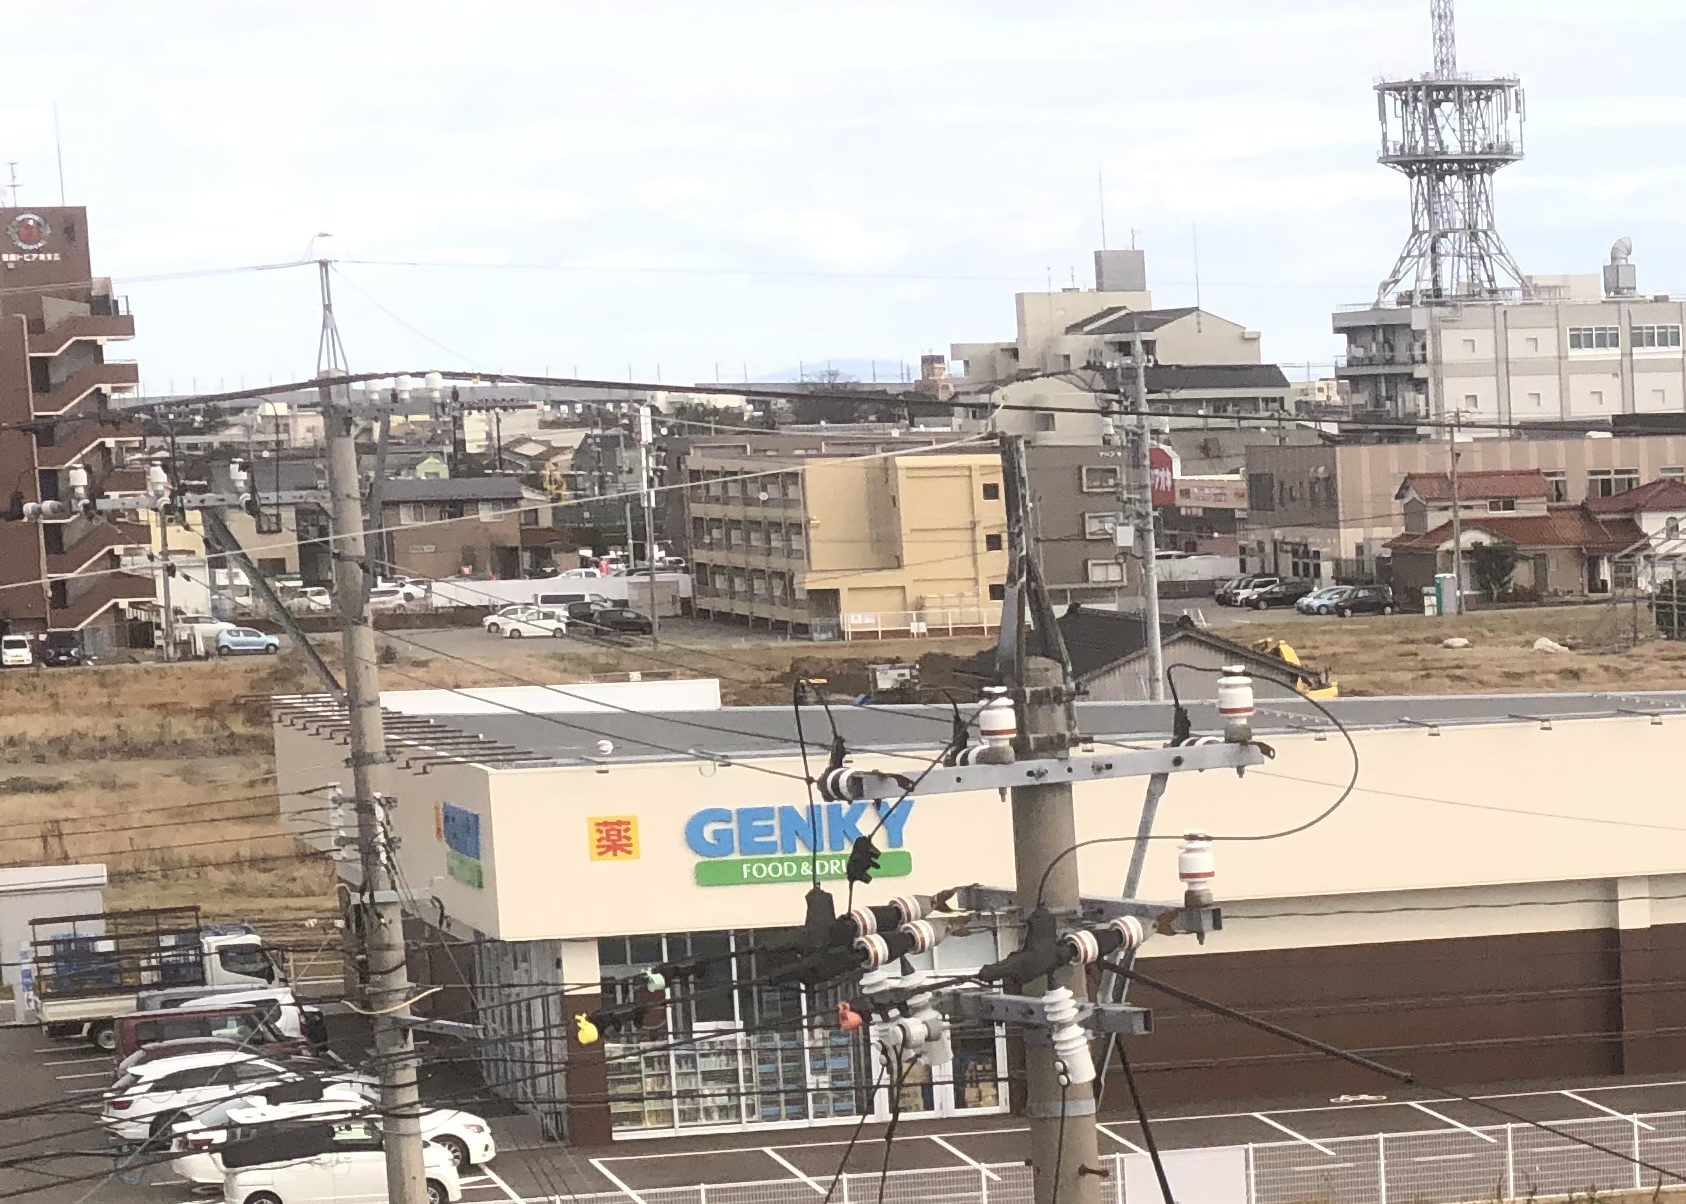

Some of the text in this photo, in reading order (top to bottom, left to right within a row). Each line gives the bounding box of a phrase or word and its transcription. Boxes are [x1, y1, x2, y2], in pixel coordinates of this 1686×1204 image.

[594, 820, 633, 857] 薬
[685, 800, 914, 858] GENKY
[742, 862, 797, 879] FOOD
[815, 859, 848, 875] DR
